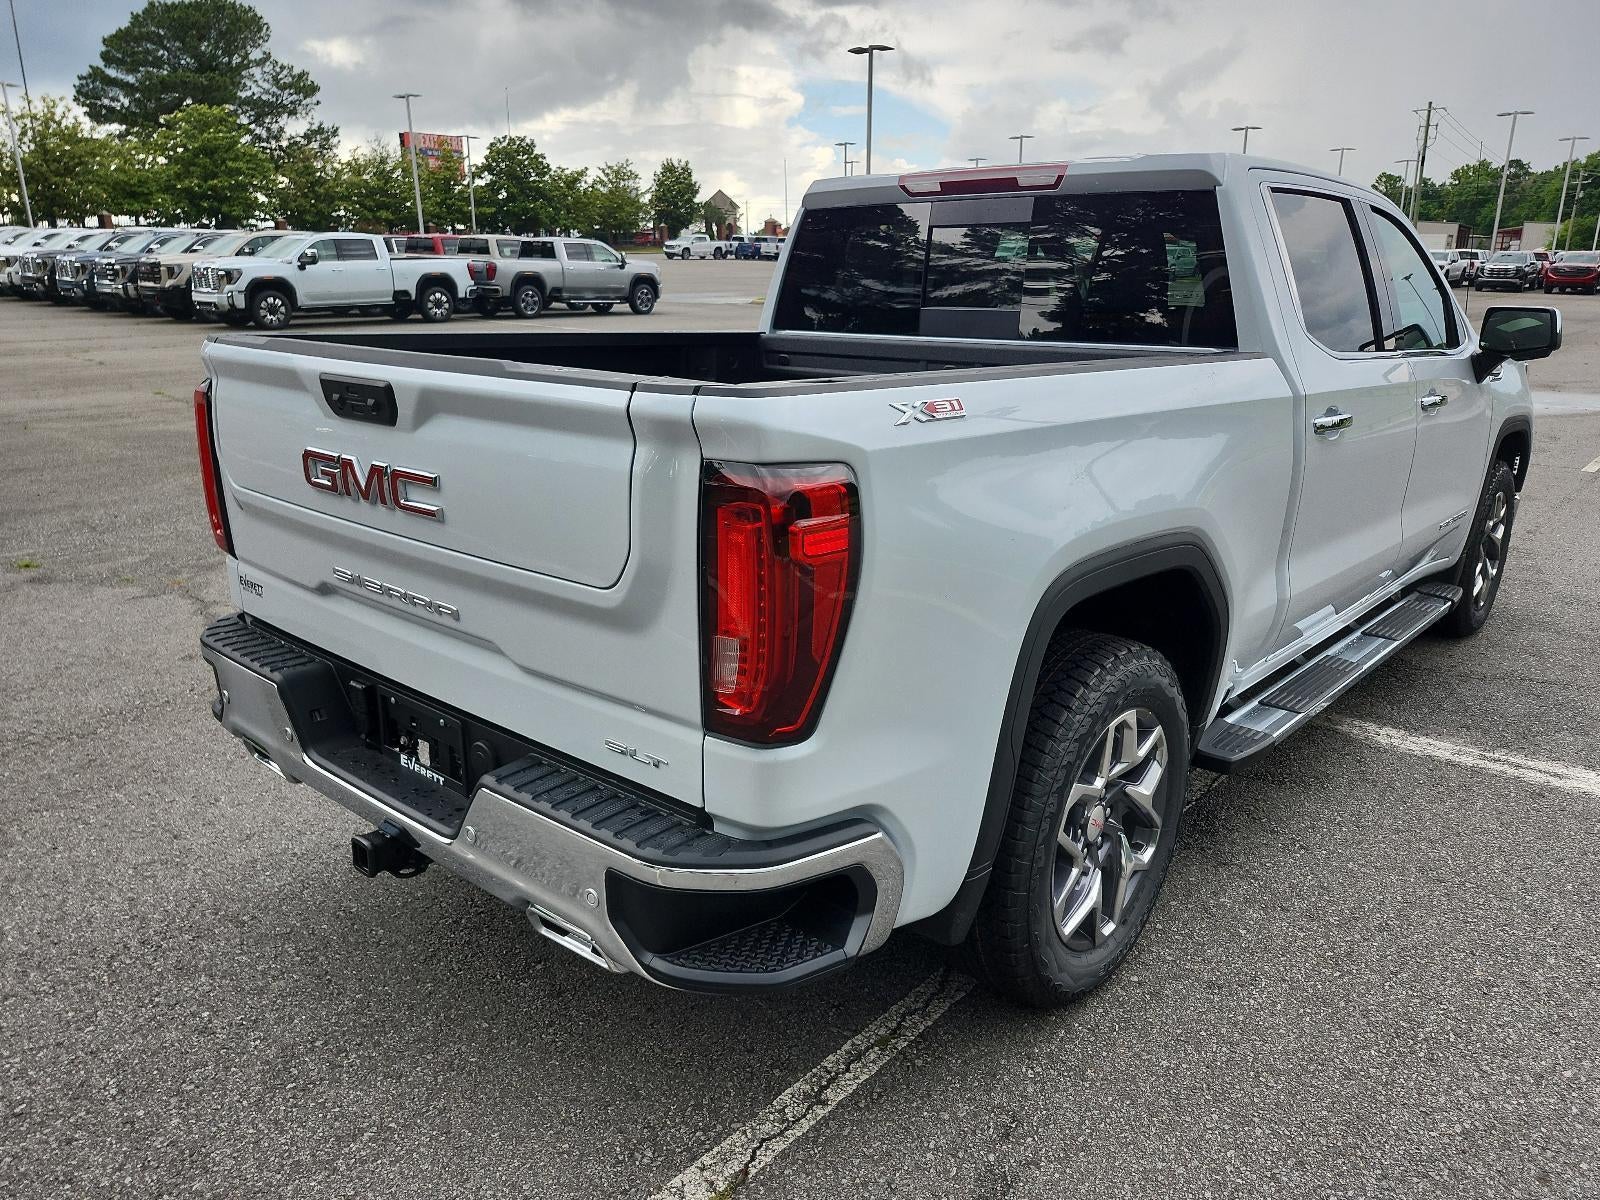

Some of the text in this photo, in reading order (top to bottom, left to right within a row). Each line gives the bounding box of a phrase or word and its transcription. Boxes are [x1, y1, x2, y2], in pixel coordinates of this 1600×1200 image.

[302, 446, 445, 523] GMC
[333, 566, 460, 622] SIERRA
[400, 753, 445, 786] EVERETT
[604, 738, 669, 769] SLT
